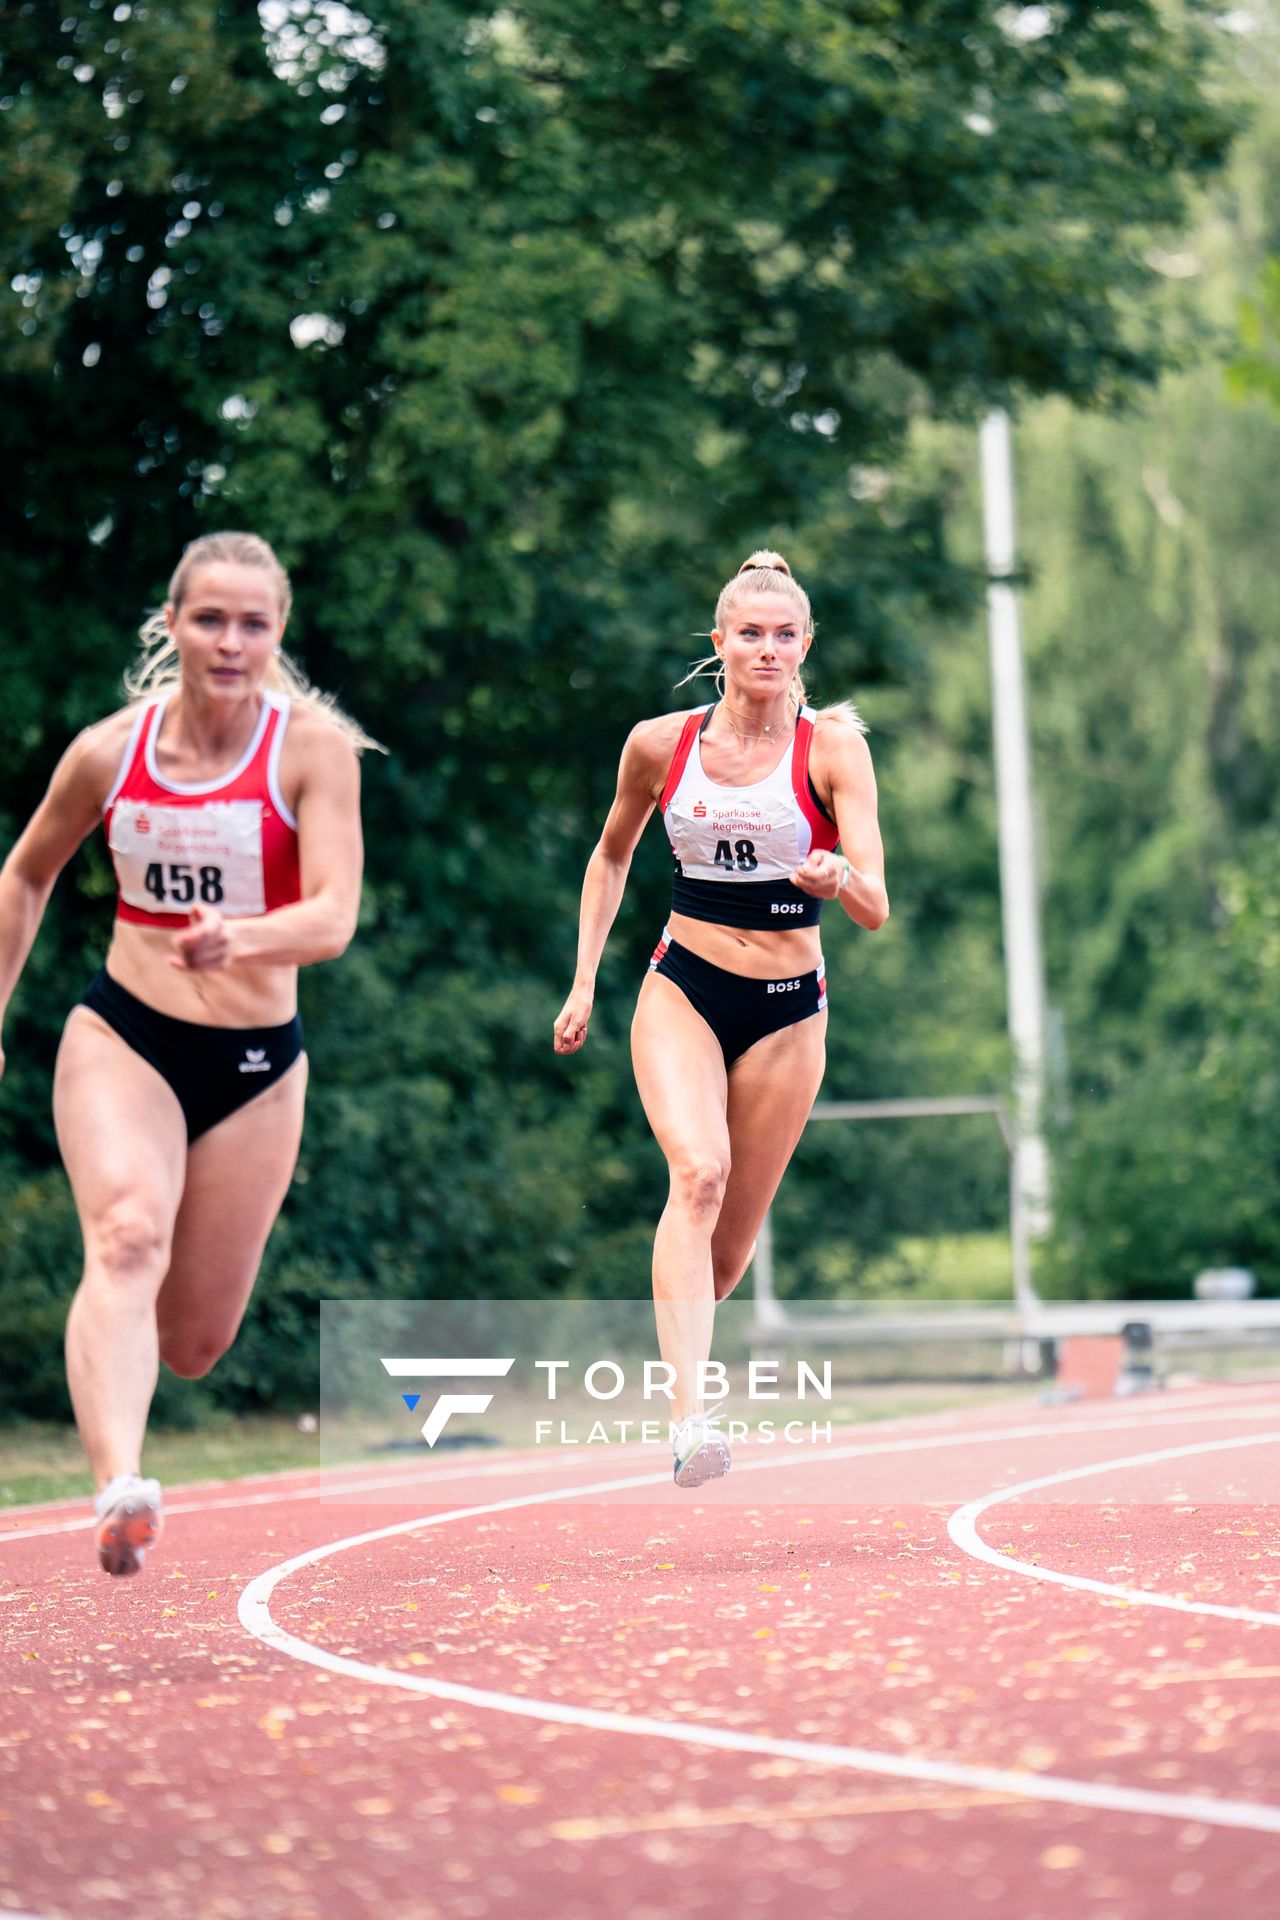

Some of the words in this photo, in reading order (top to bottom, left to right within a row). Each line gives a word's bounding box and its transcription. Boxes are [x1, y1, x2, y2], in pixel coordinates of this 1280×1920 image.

[712, 809, 761, 820] Sparkasse
[712, 822, 772, 833] Regensburg
[714, 839, 759, 872] 48
[145, 862, 224, 904] 458
[770, 903, 804, 914] BOSS
[767, 979, 801, 994] BOSS
